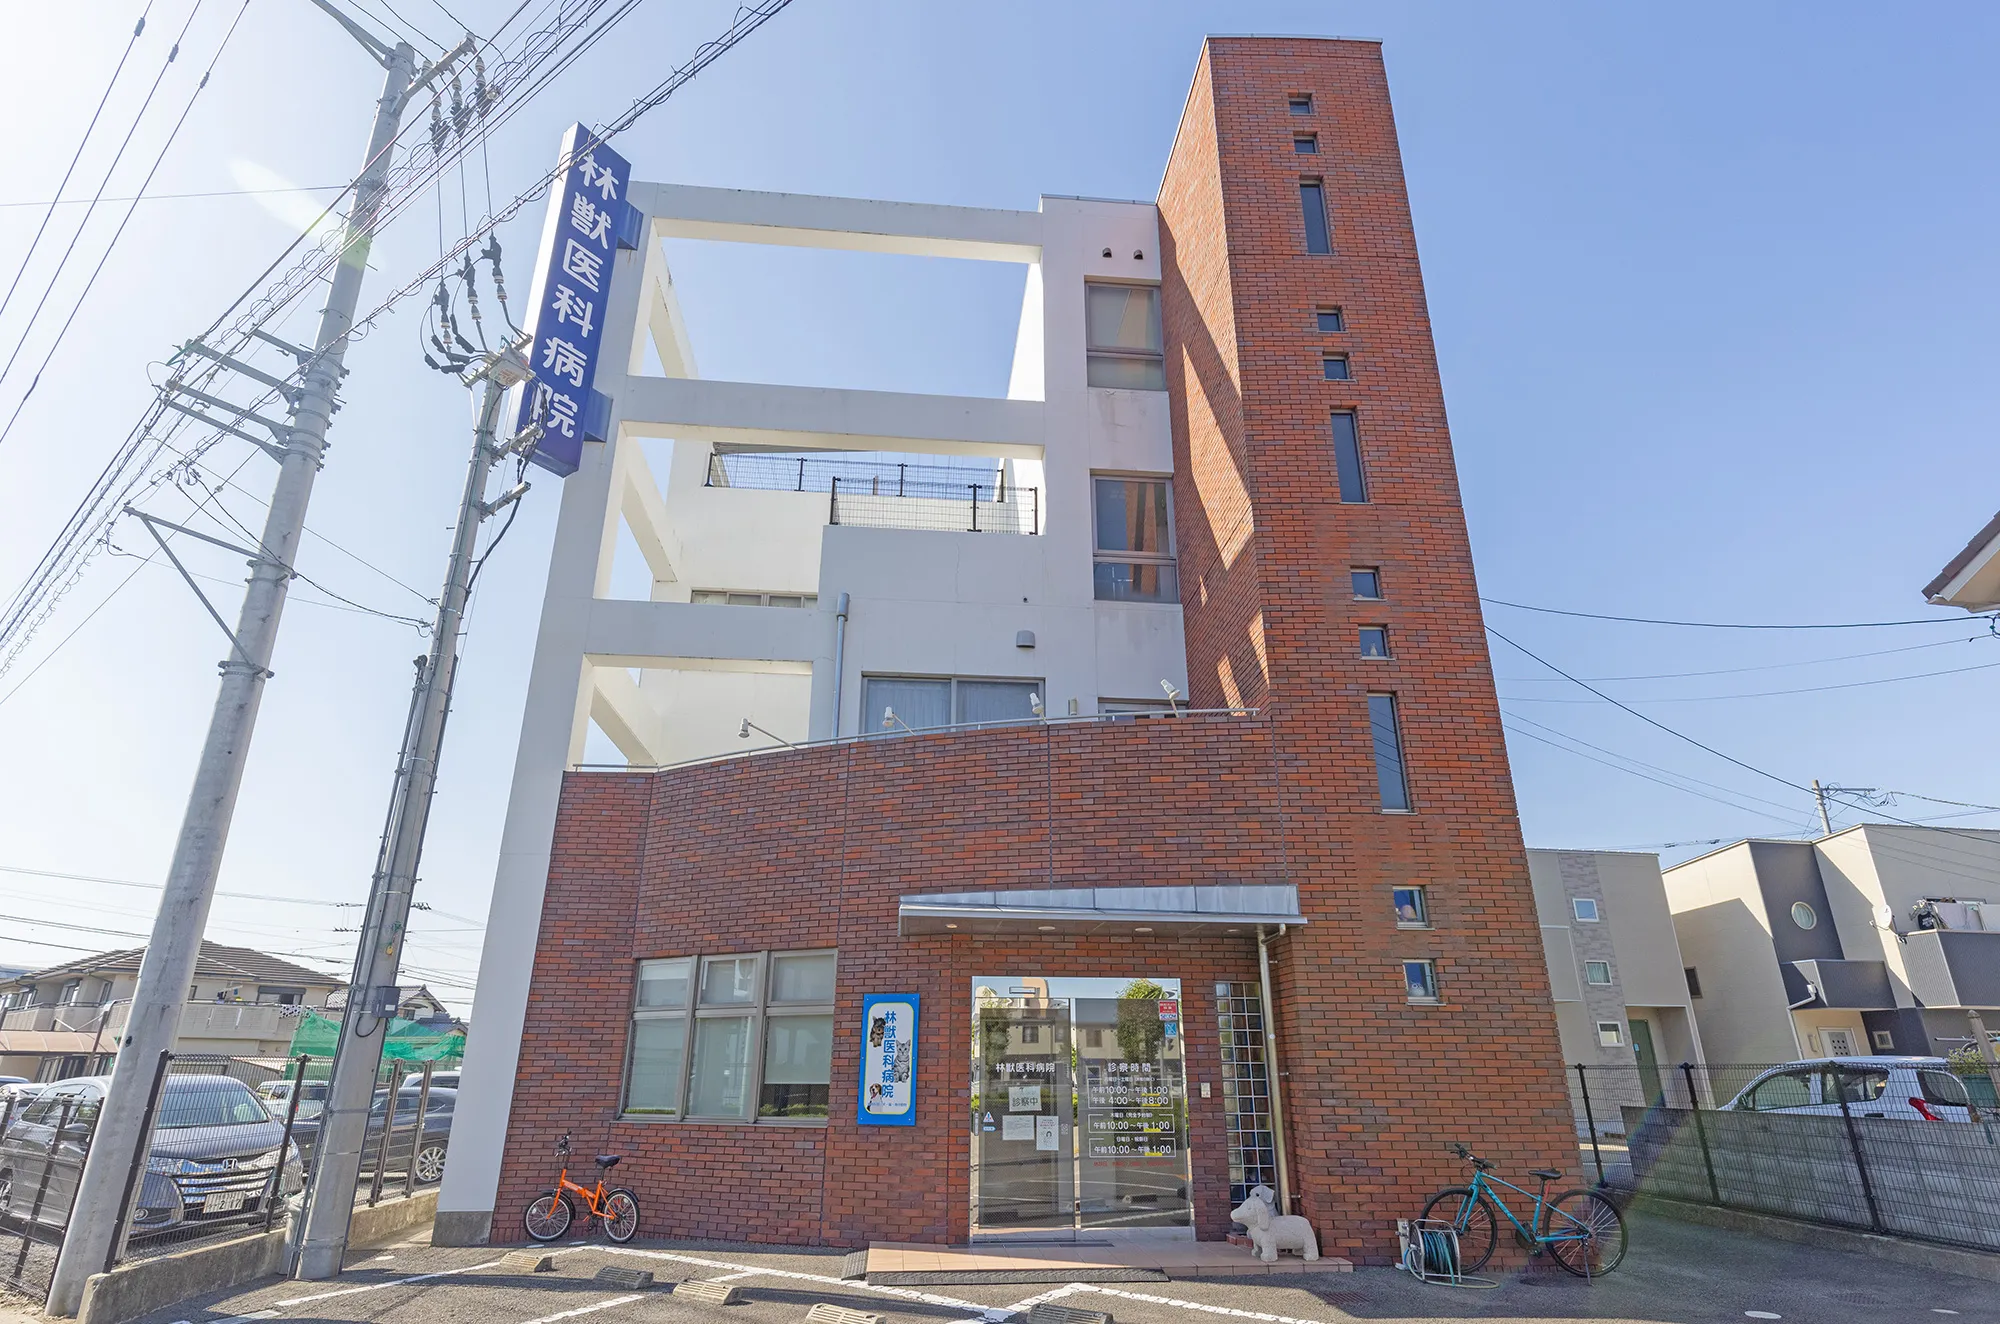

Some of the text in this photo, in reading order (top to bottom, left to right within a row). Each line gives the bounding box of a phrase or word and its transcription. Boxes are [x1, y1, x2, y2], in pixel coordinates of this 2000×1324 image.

[532, 152, 619, 438] 林獣医科病院
[880, 1010, 897, 1098] 林獣医科病院
[995, 1062, 1055, 1073] 林獣医科病院
[1107, 1062, 1152, 1073] 診察時間
[1012, 1096, 1038, 1107] 診察中
